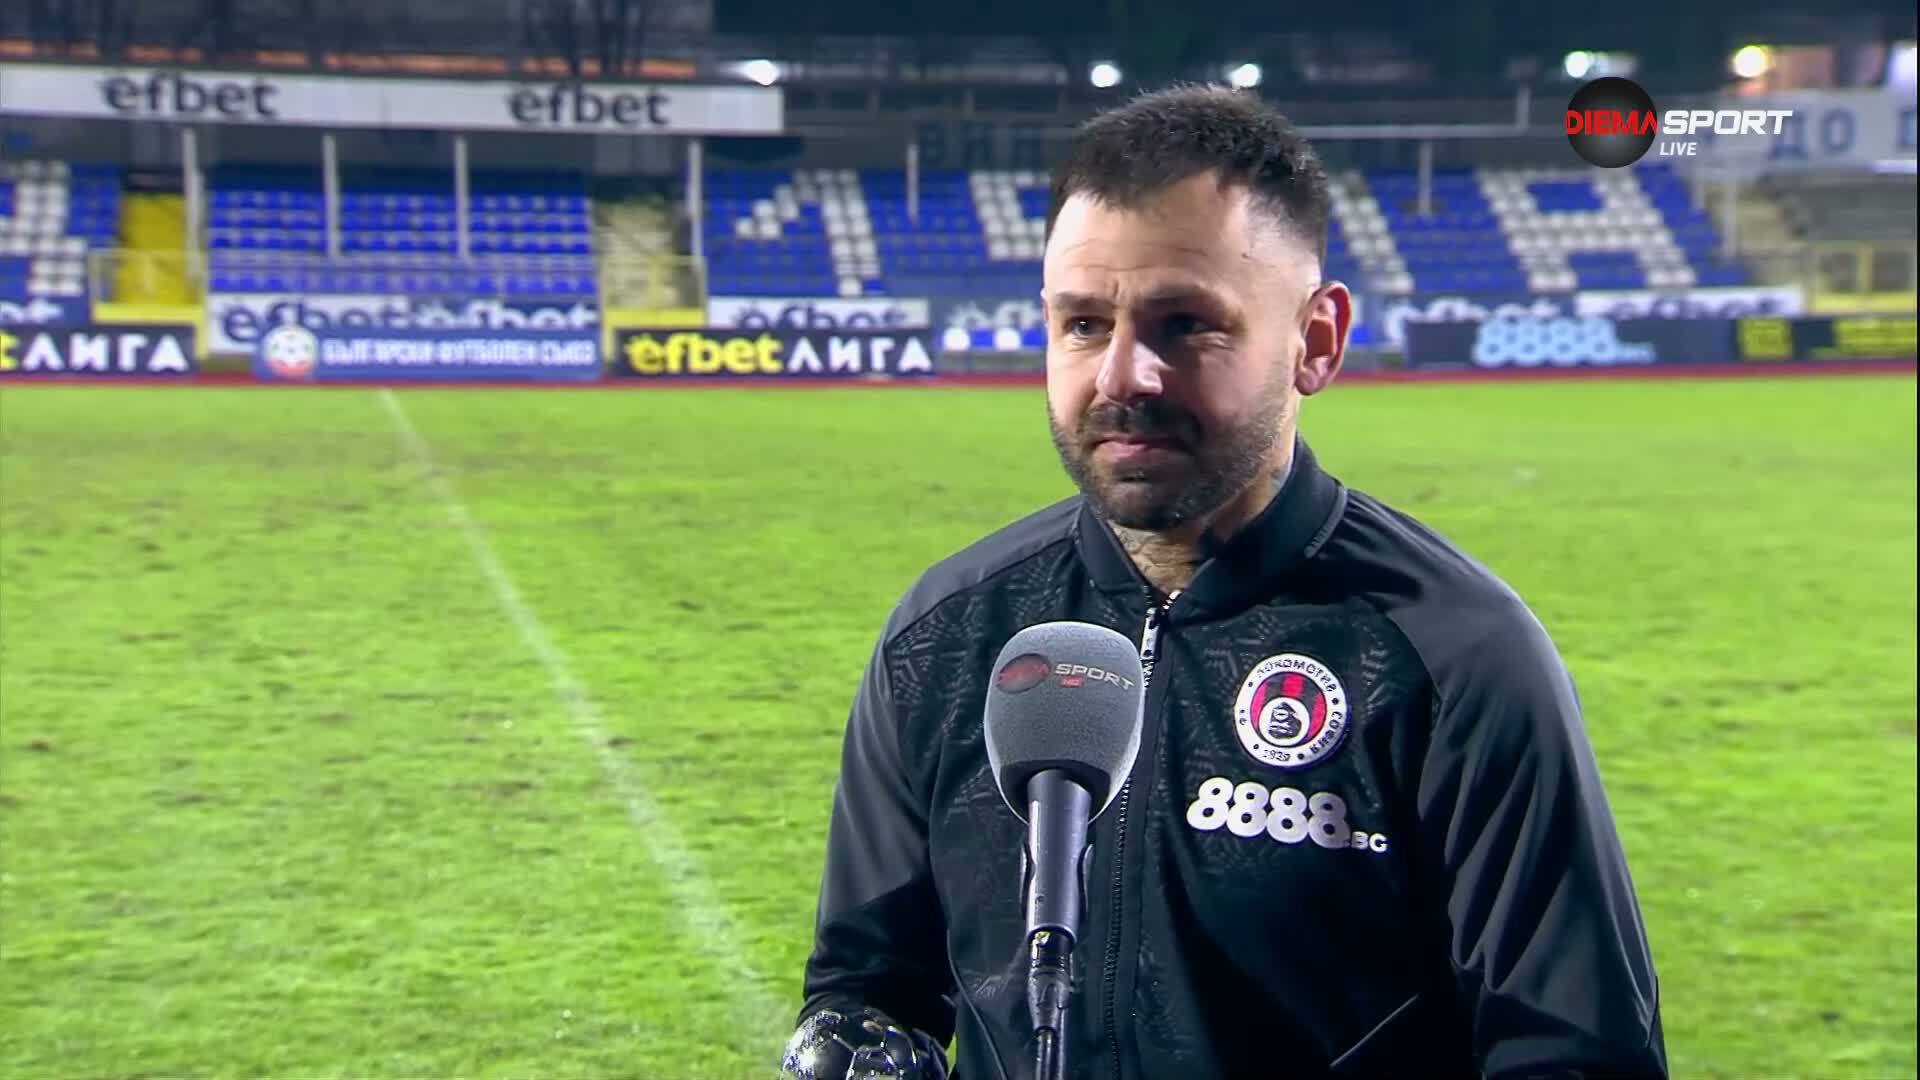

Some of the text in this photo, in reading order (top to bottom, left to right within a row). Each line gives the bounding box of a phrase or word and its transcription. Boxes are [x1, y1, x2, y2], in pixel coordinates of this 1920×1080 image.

[100, 71, 279, 118] efbet
[506, 84, 671, 126] efbet
[22, 332, 189, 371] ЛИГА
[625, 333, 933, 373] efbet ЛИГА
[1055, 663, 1136, 690] SPORT
